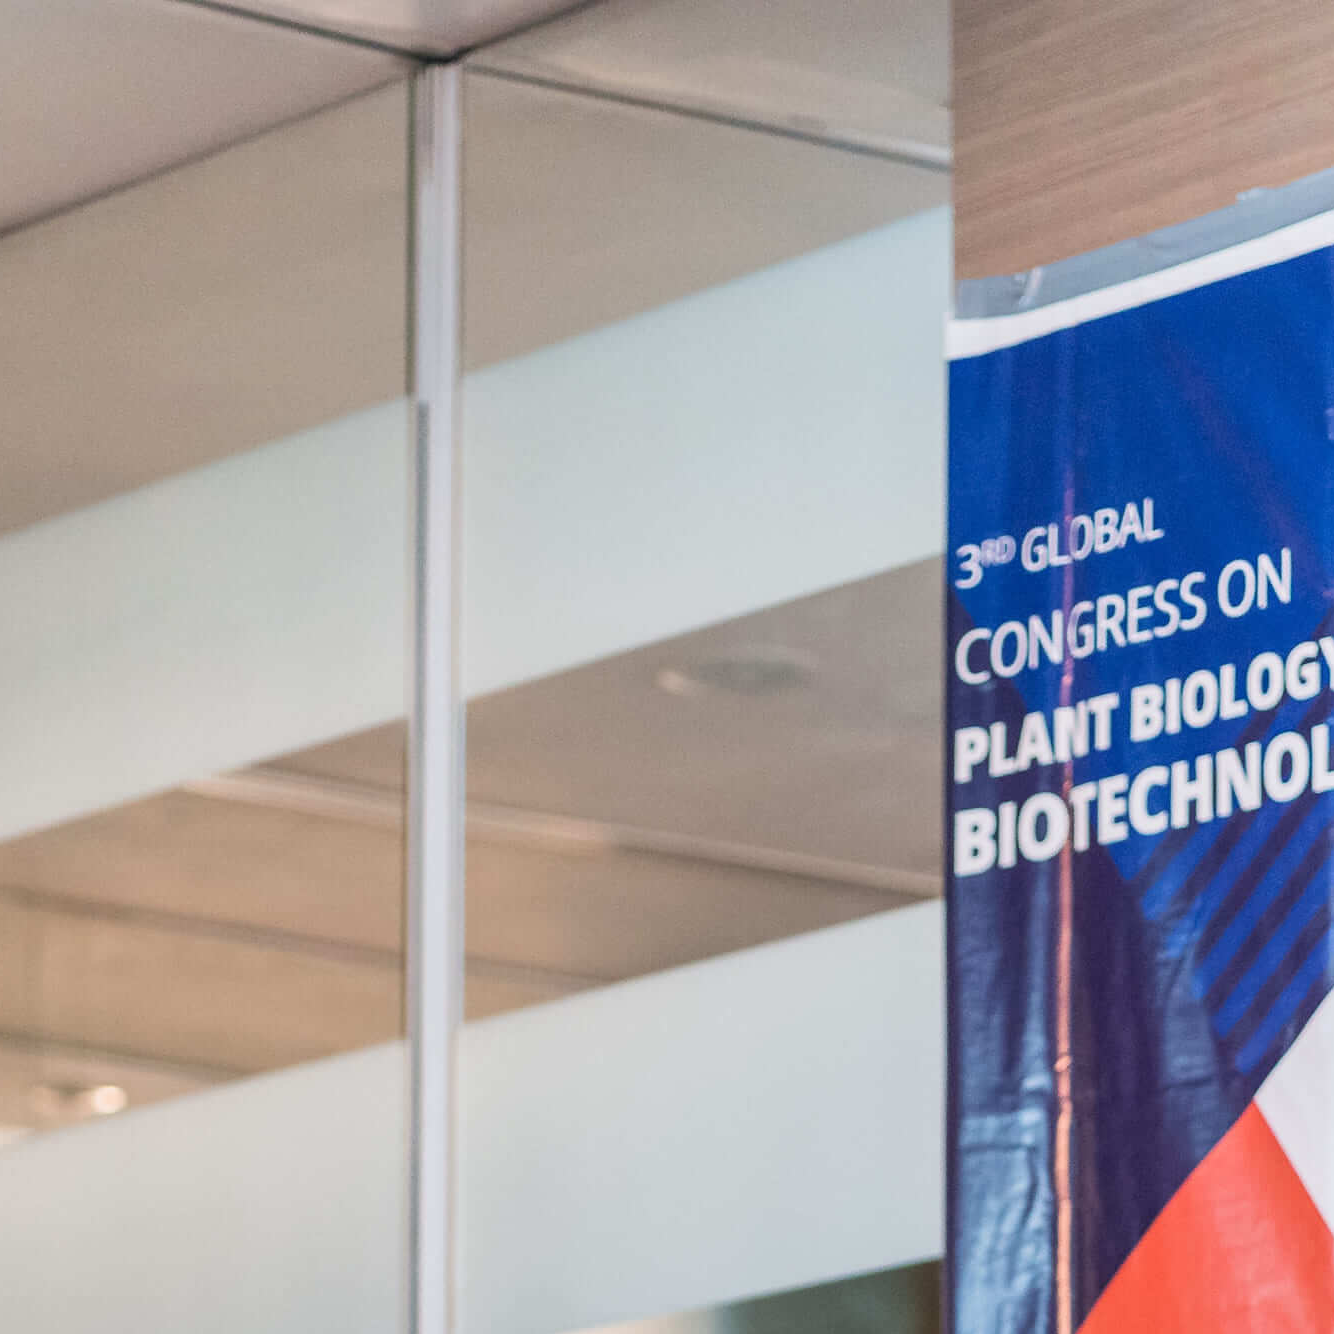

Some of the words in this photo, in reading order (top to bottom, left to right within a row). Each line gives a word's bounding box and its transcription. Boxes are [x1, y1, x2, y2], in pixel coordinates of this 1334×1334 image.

[1021, 497, 1165, 573] GLOBAL
[953, 570, 1208, 685] CONGRESS
[1216, 546, 1292, 618] ON
[953, 691, 1120, 784] PLANT
